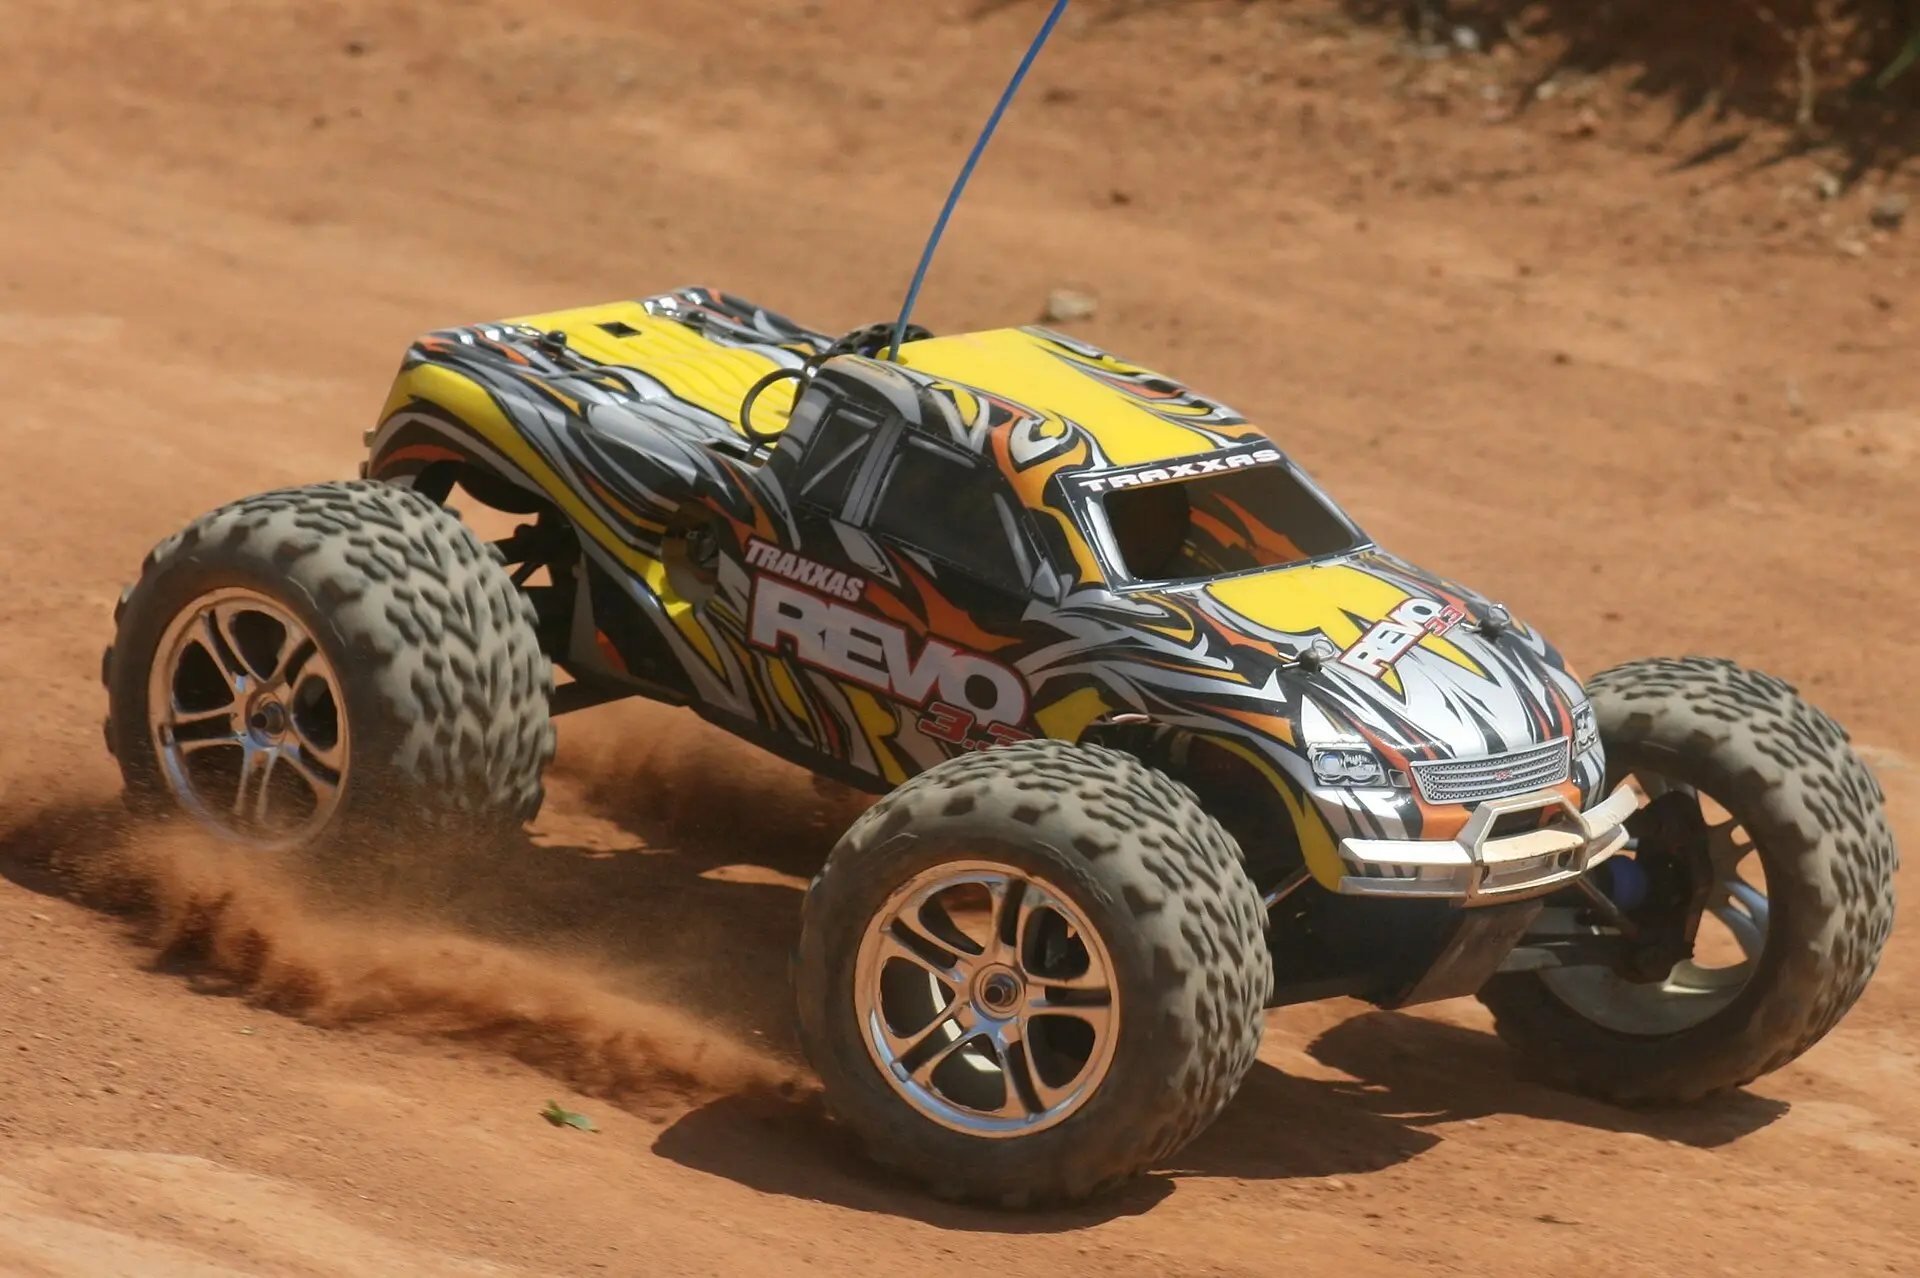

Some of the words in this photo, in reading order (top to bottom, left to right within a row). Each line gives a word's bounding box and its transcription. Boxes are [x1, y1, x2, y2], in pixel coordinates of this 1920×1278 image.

[1079, 449, 1281, 492] TRAXXAS
[745, 540, 864, 601] TRAXXAS
[750, 573, 1028, 728] REVO
[1340, 598, 1442, 677] REVO
